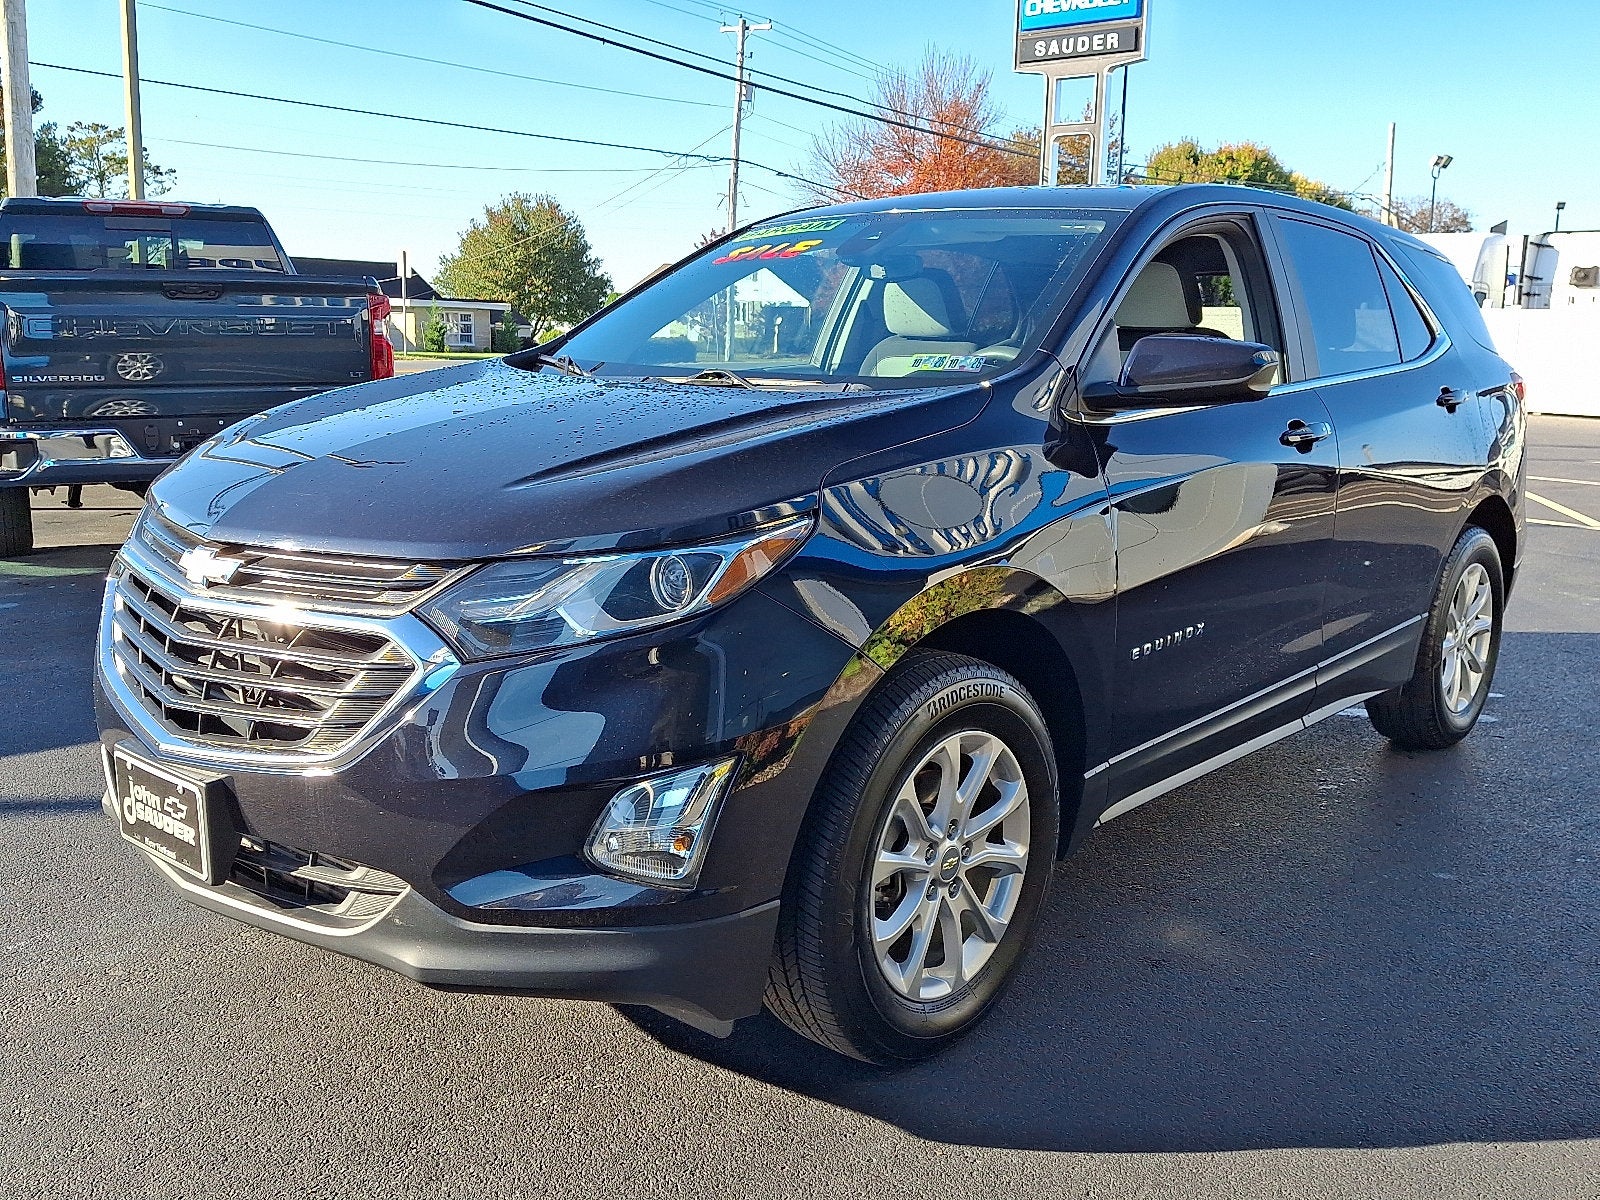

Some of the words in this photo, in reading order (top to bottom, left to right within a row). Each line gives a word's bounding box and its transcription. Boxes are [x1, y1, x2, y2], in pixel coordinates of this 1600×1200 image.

[1034, 32, 1119, 57] SAUDER
[712, 239, 823, 265] SALE
[912, 358, 923, 368] 10
[948, 358, 960, 369] 10
[11, 374, 106, 383] SILVERADO
[1131, 622, 1206, 660] EQUINOX
[926, 682, 1006, 722] BRIDGESTONE
[135, 801, 196, 847] SAUDER
